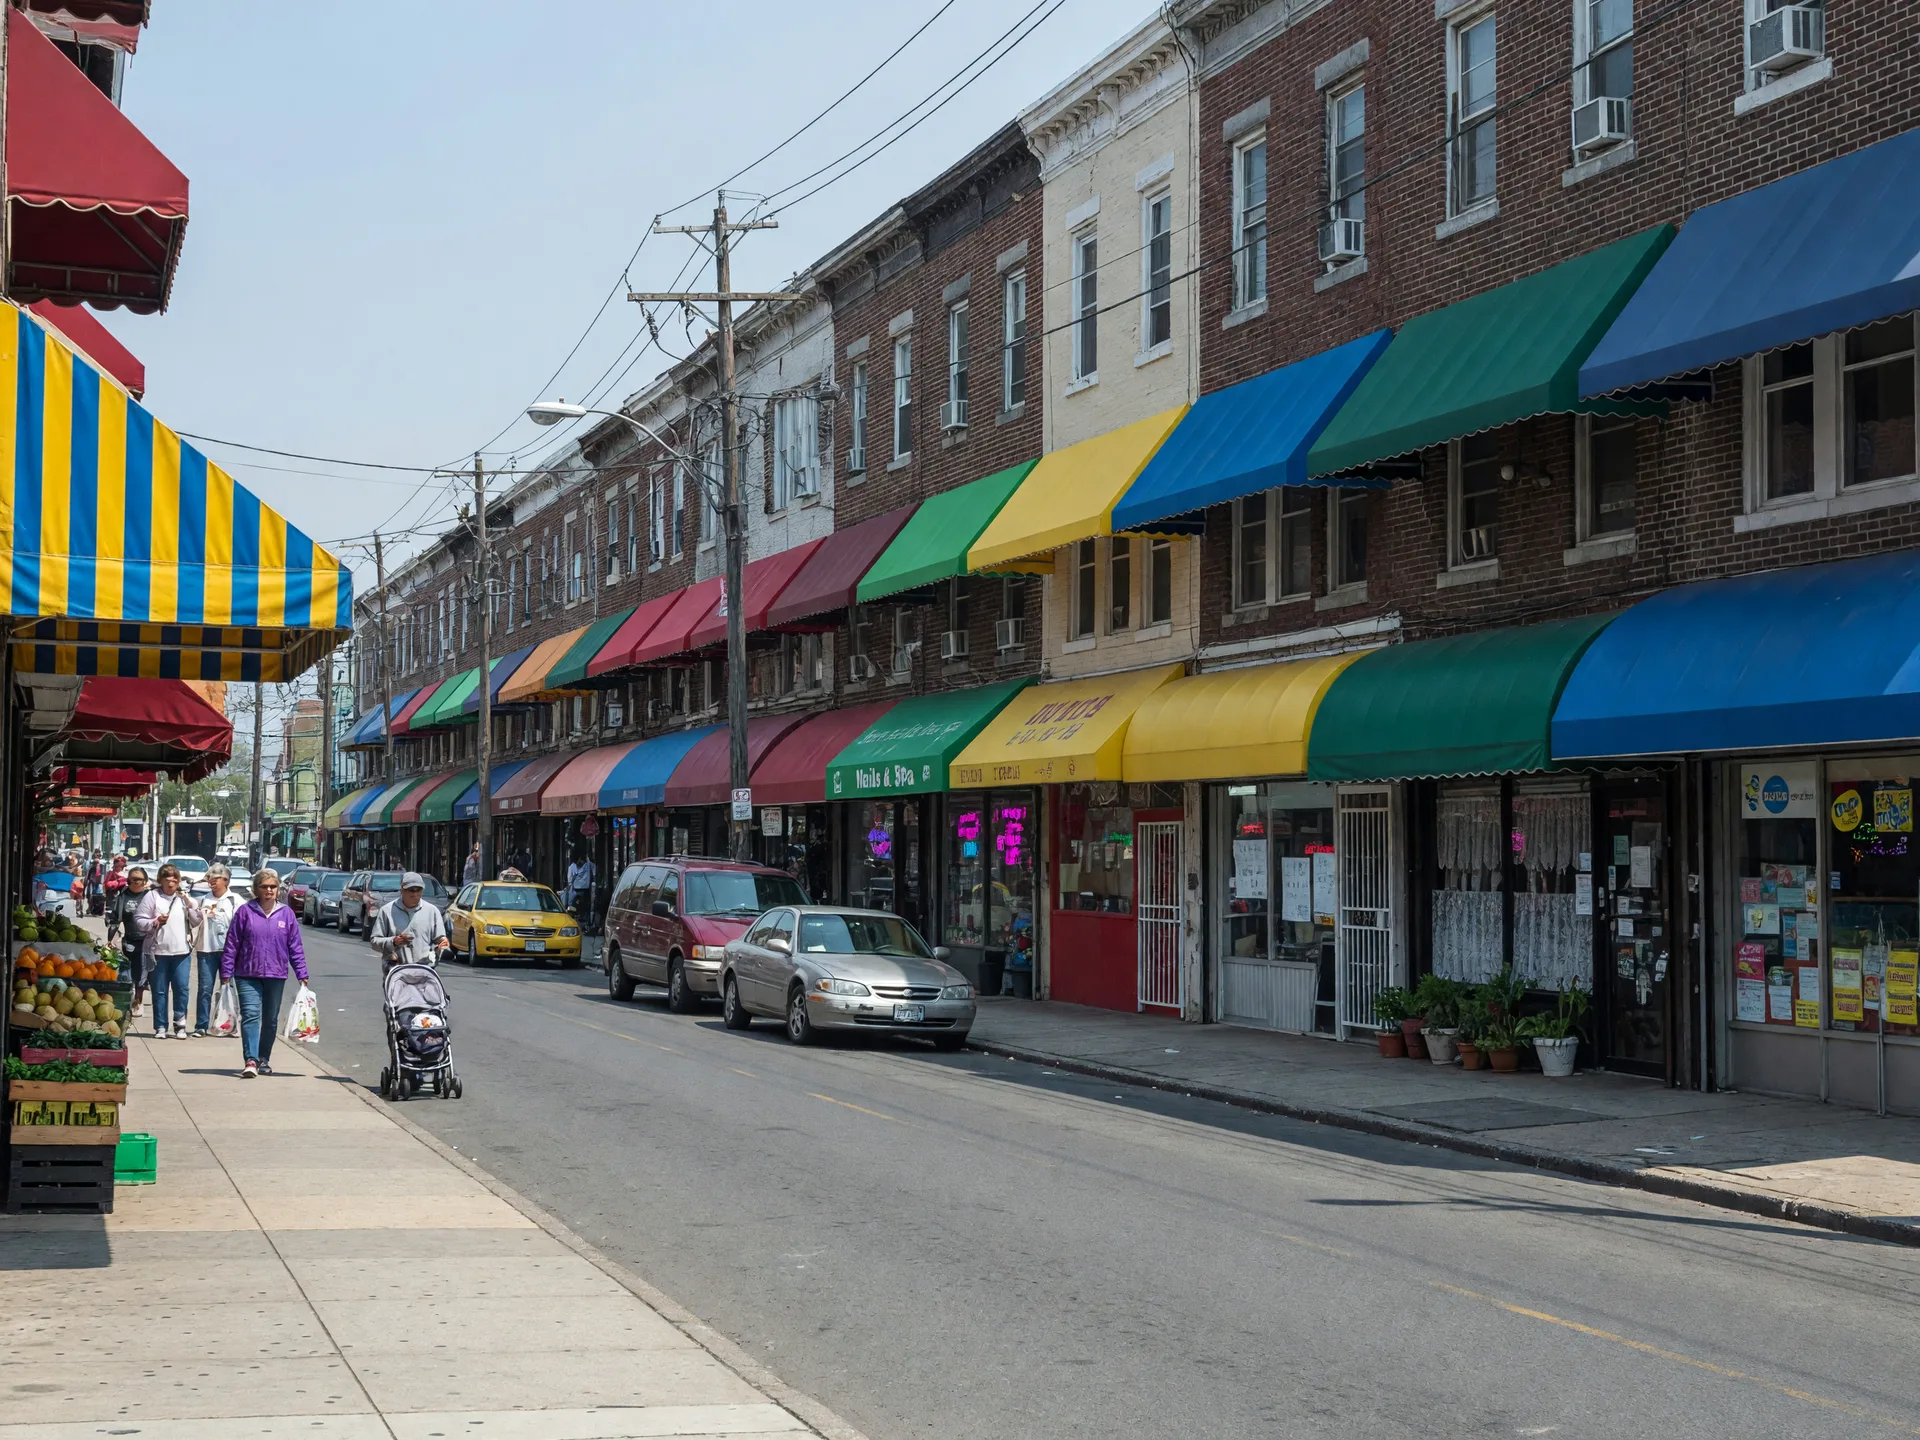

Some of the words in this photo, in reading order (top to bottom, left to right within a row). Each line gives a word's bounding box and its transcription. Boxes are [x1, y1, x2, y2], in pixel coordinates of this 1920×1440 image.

[856, 768, 880, 788] Nails
[884, 767, 892, 787] &
[895, 765, 915, 787] Spa
